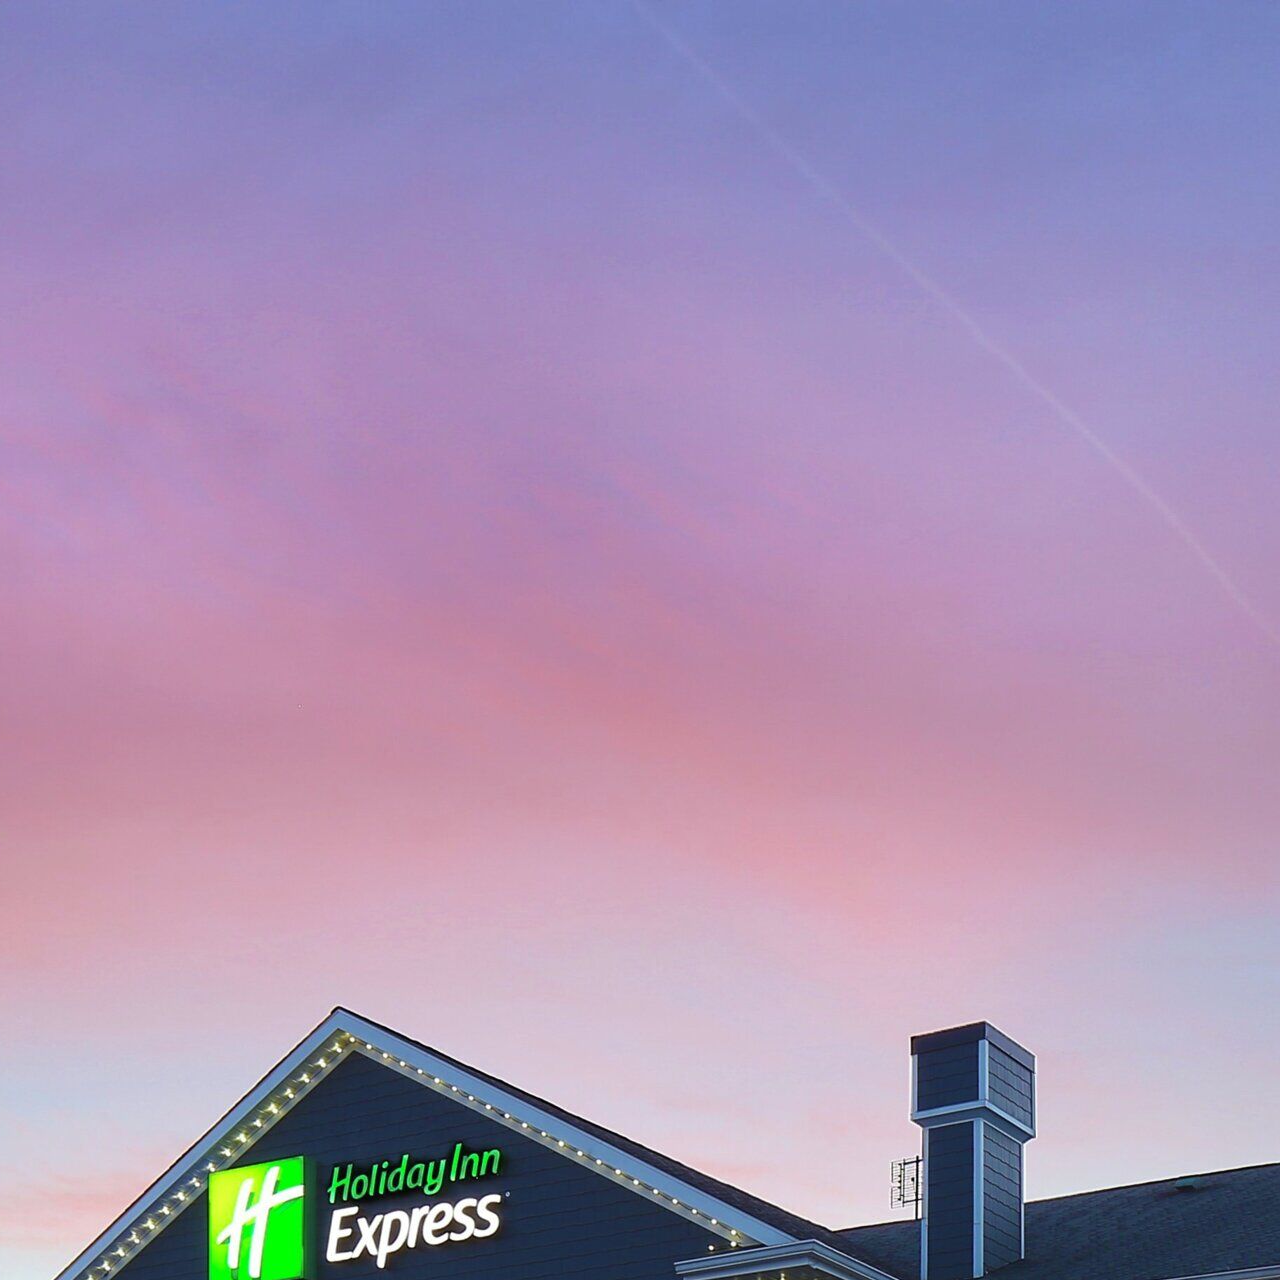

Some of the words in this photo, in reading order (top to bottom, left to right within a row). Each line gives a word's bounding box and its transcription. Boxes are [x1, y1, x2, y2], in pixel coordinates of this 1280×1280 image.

[327, 1154, 447, 1204] Holiday
[450, 1143, 501, 1182] Inn
[326, 1194, 502, 1269] Express
